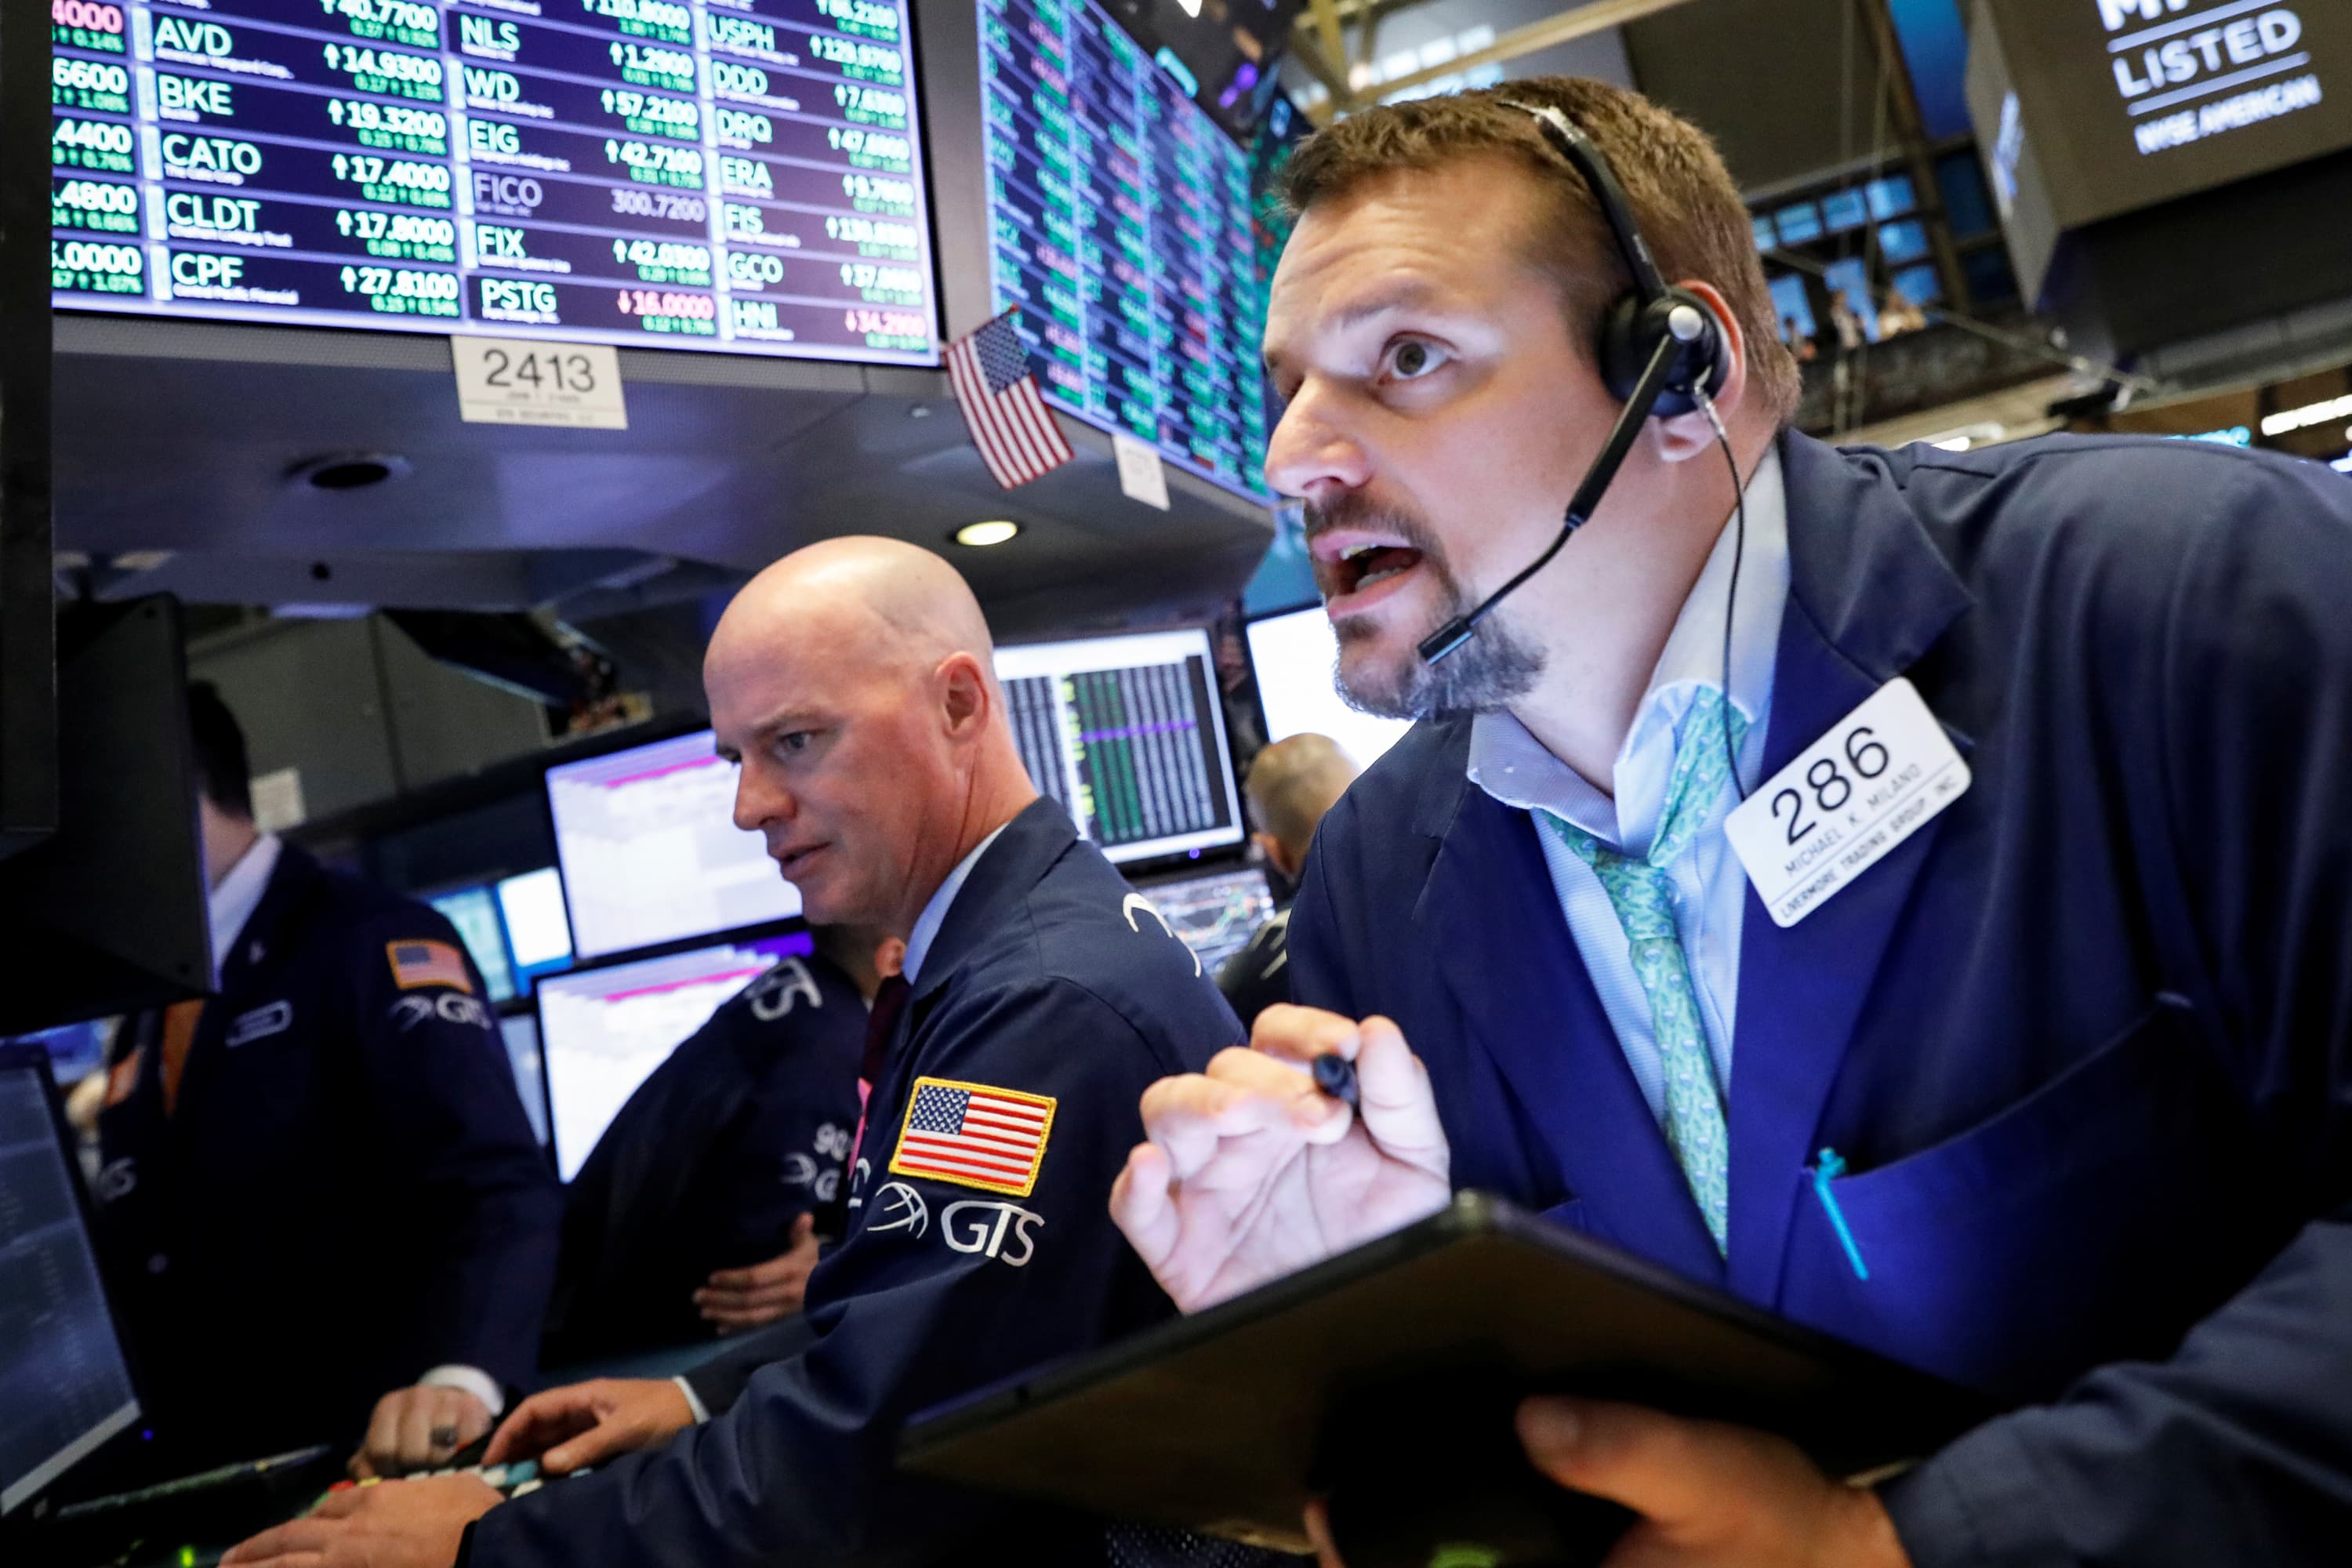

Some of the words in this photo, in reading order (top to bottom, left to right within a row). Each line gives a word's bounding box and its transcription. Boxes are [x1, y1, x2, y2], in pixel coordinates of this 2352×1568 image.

[154, 16, 232, 56] AVD
[460, 14, 521, 53] NLS
[709, 14, 775, 53] USPH
[342, 45, 443, 85] 14.9300
[2112, 9, 2303, 98] LISTED
[158, 74, 234, 116] BKE
[463, 67, 520, 103] WD
[712, 61, 768, 96] DDD
[346, 101, 447, 139] 19.3200
[469, 120, 520, 154] EIG
[716, 108, 773, 143] DRQ
[162, 134, 262, 174] CATO
[350, 155, 452, 191] 17.4000
[474, 171, 543, 208] FICO
[720, 156, 774, 190] ERA
[166, 194, 261, 231] CLDT
[612, 188, 705, 222] 300.7200
[724, 203, 764, 234] FIS
[354, 211, 456, 246] 17.8000
[476, 224, 527, 258] FIX
[171, 252, 244, 288] CPF
[358, 267, 459, 300] 27.8100
[728, 252, 784, 283] GCO
[481, 278, 558, 312] PSTG
[731, 299, 779, 329] HNI
[483, 347, 595, 393] 2413
[1770, 726, 1890, 847] 286
[1784, 827, 1843, 877] MICHAEL
[1866, 762, 1922, 811] MILANO
[941, 1200, 1046, 1267] GTS
